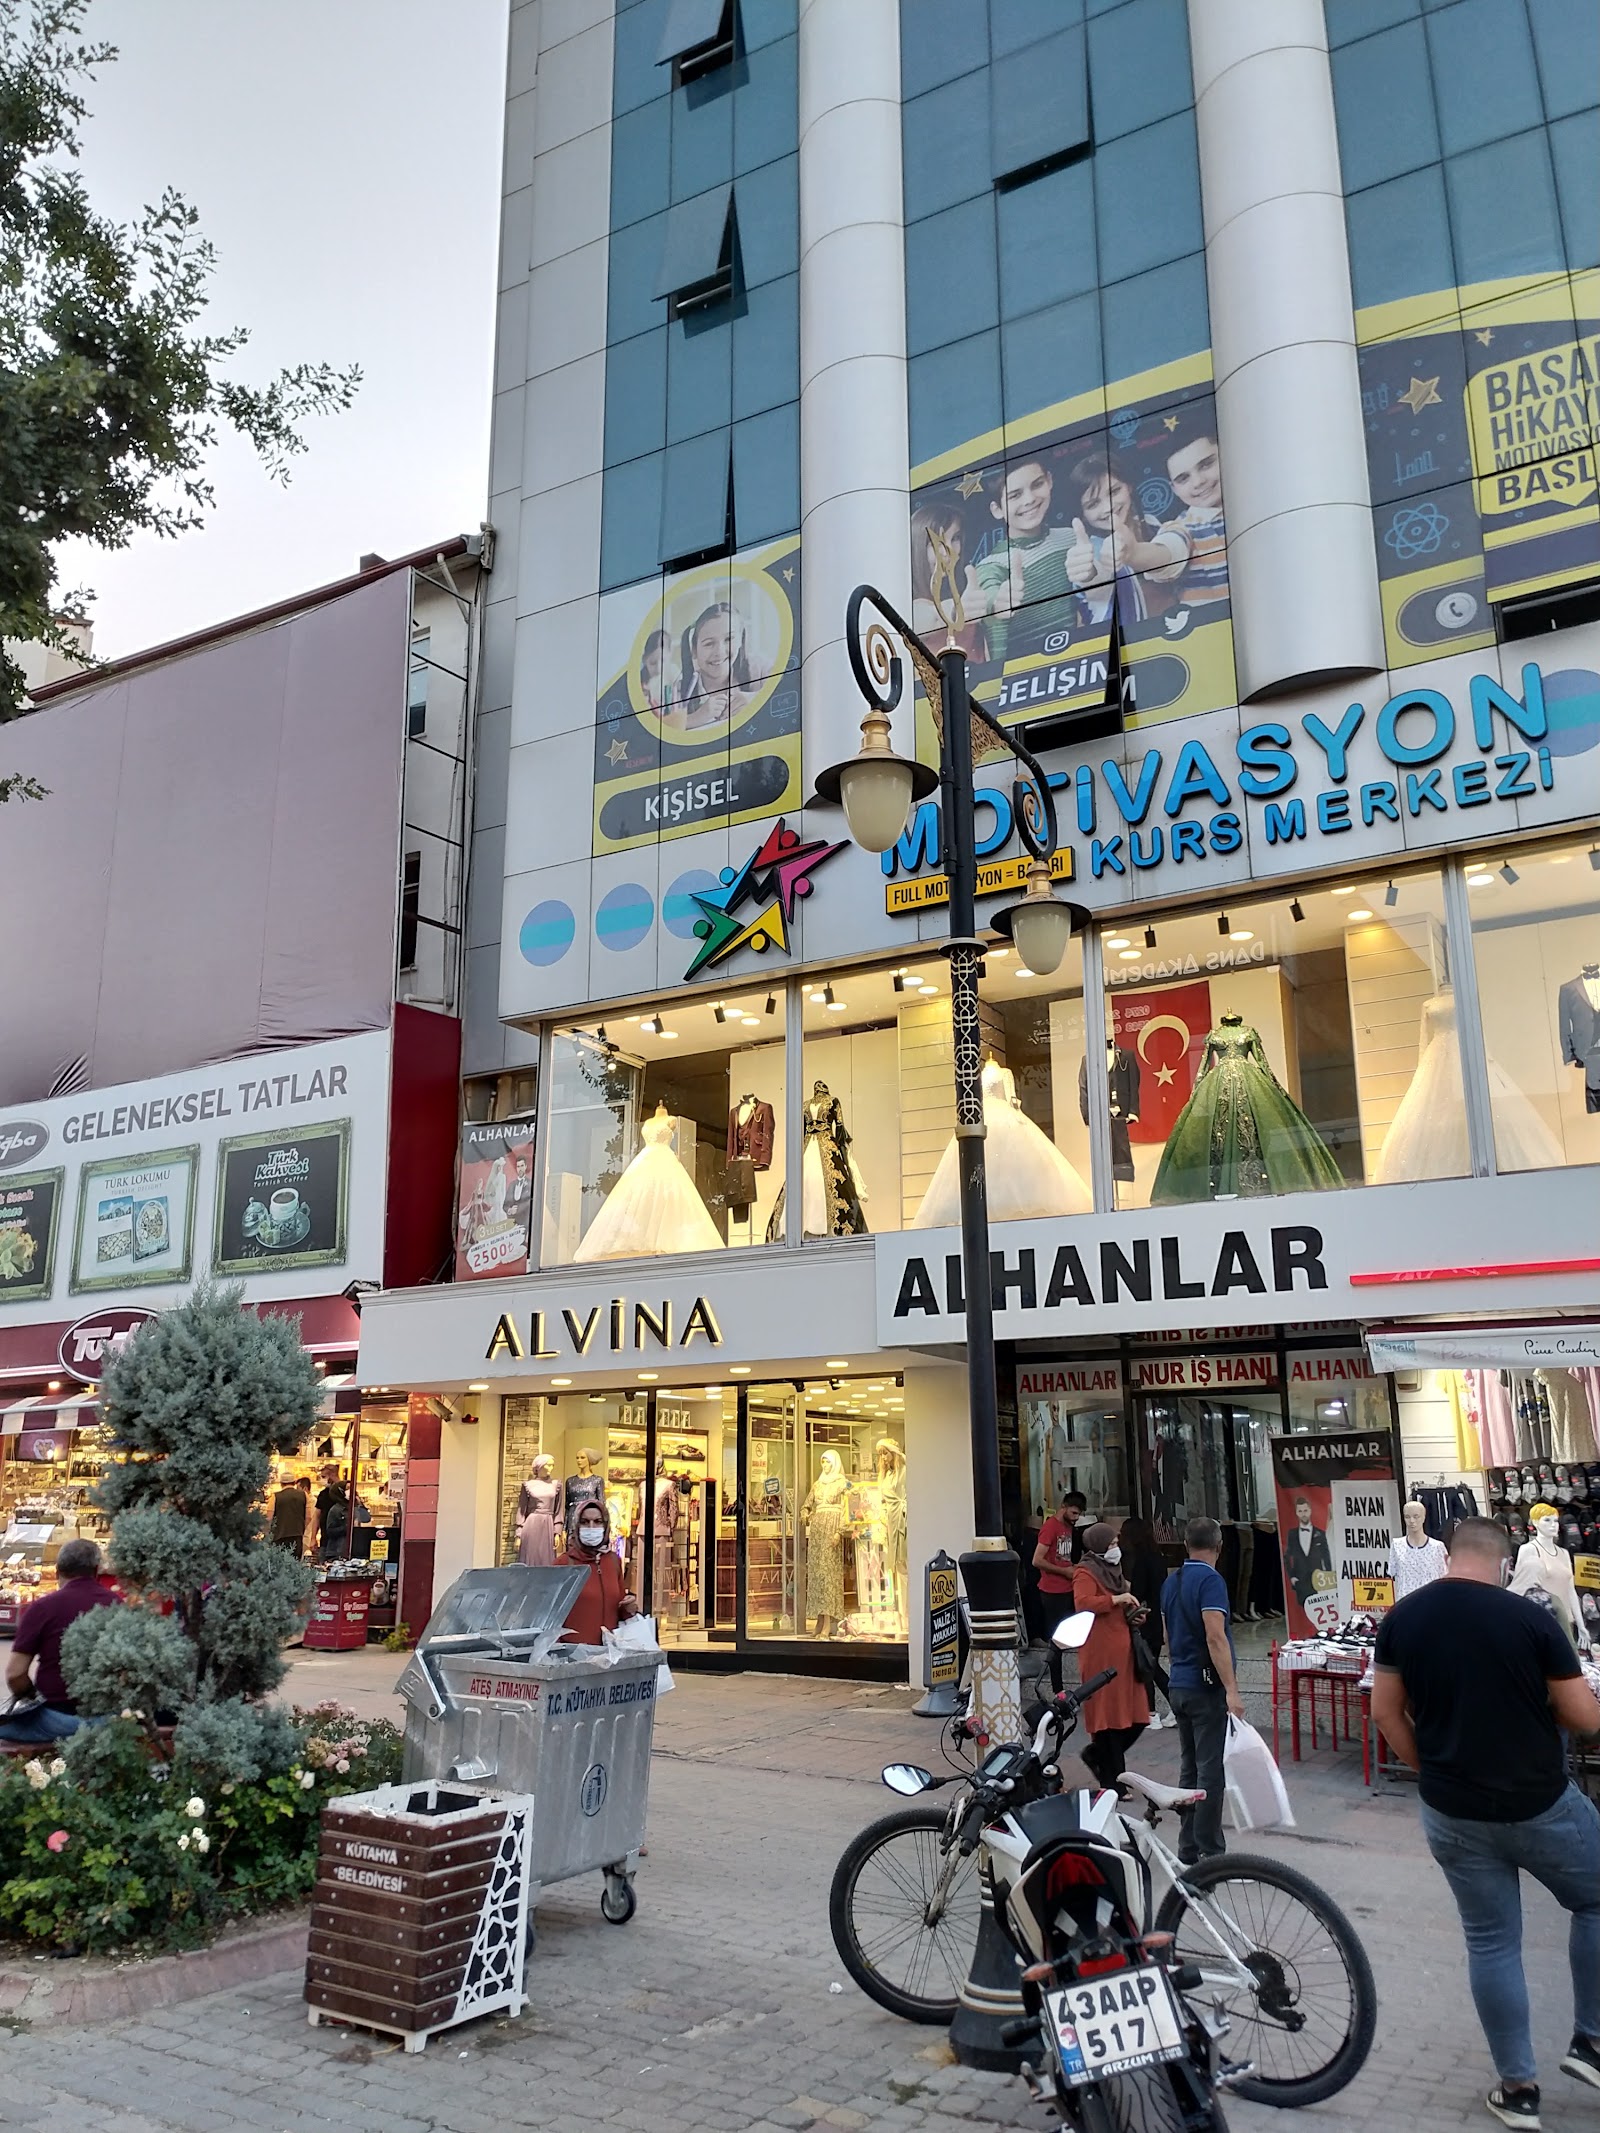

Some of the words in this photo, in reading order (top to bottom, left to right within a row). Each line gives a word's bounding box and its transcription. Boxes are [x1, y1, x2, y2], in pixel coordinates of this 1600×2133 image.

[645, 778, 739, 822] KİŞİSEL
[1091, 812, 1242, 878] KURS
[1265, 747, 1554, 845] MERKEZİ
[893, 887, 922, 905] FULL
[925, 868, 1002, 899] MOTYON
[62, 1087, 232, 1144] GELENEKSEL
[239, 1065, 348, 1112] TATLAR
[468, 1122, 535, 1143] ALHANLAR
[254, 1157, 310, 1181] Kahvesi
[267, 1147, 299, 1167] Türk
[104, 1175, 129, 1190] TÜRK
[131, 1169, 171, 1186] LOKUMU
[893, 1225, 1329, 1318] ALHANLAR
[485, 1297, 723, 1361] ALVİNA
[1373, 1340, 1415, 1353] Berrak
[1019, 1368, 1118, 1394] ALHANLAR
[1138, 1361, 1185, 1386] NUR
[1191, 1359, 1211, 1387] İŞ
[1217, 1356, 1272, 1382] HANI
[1281, 1442, 1381, 1462] ALHANLAR
[1345, 1496, 1385, 1517] BAYAN
[1345, 1528, 1391, 1549] ELEMAN
[1341, 1560, 1396, 1581] ALINACA
[470, 1678, 492, 1699] ATEŞ
[496, 1681, 540, 1701] ATMAYINIZ
[565, 1686, 606, 1713] KÜTAHYA
[345, 1841, 398, 1866] KÜTAHYA
[337, 1866, 403, 1893] BELEDİYESİ
[1058, 1976, 1156, 2026] 43AAP
[1086, 2017, 1146, 2058] 517
[1068, 2058, 1083, 2072] TR
[1101, 2052, 1155, 2077] ARZUM
